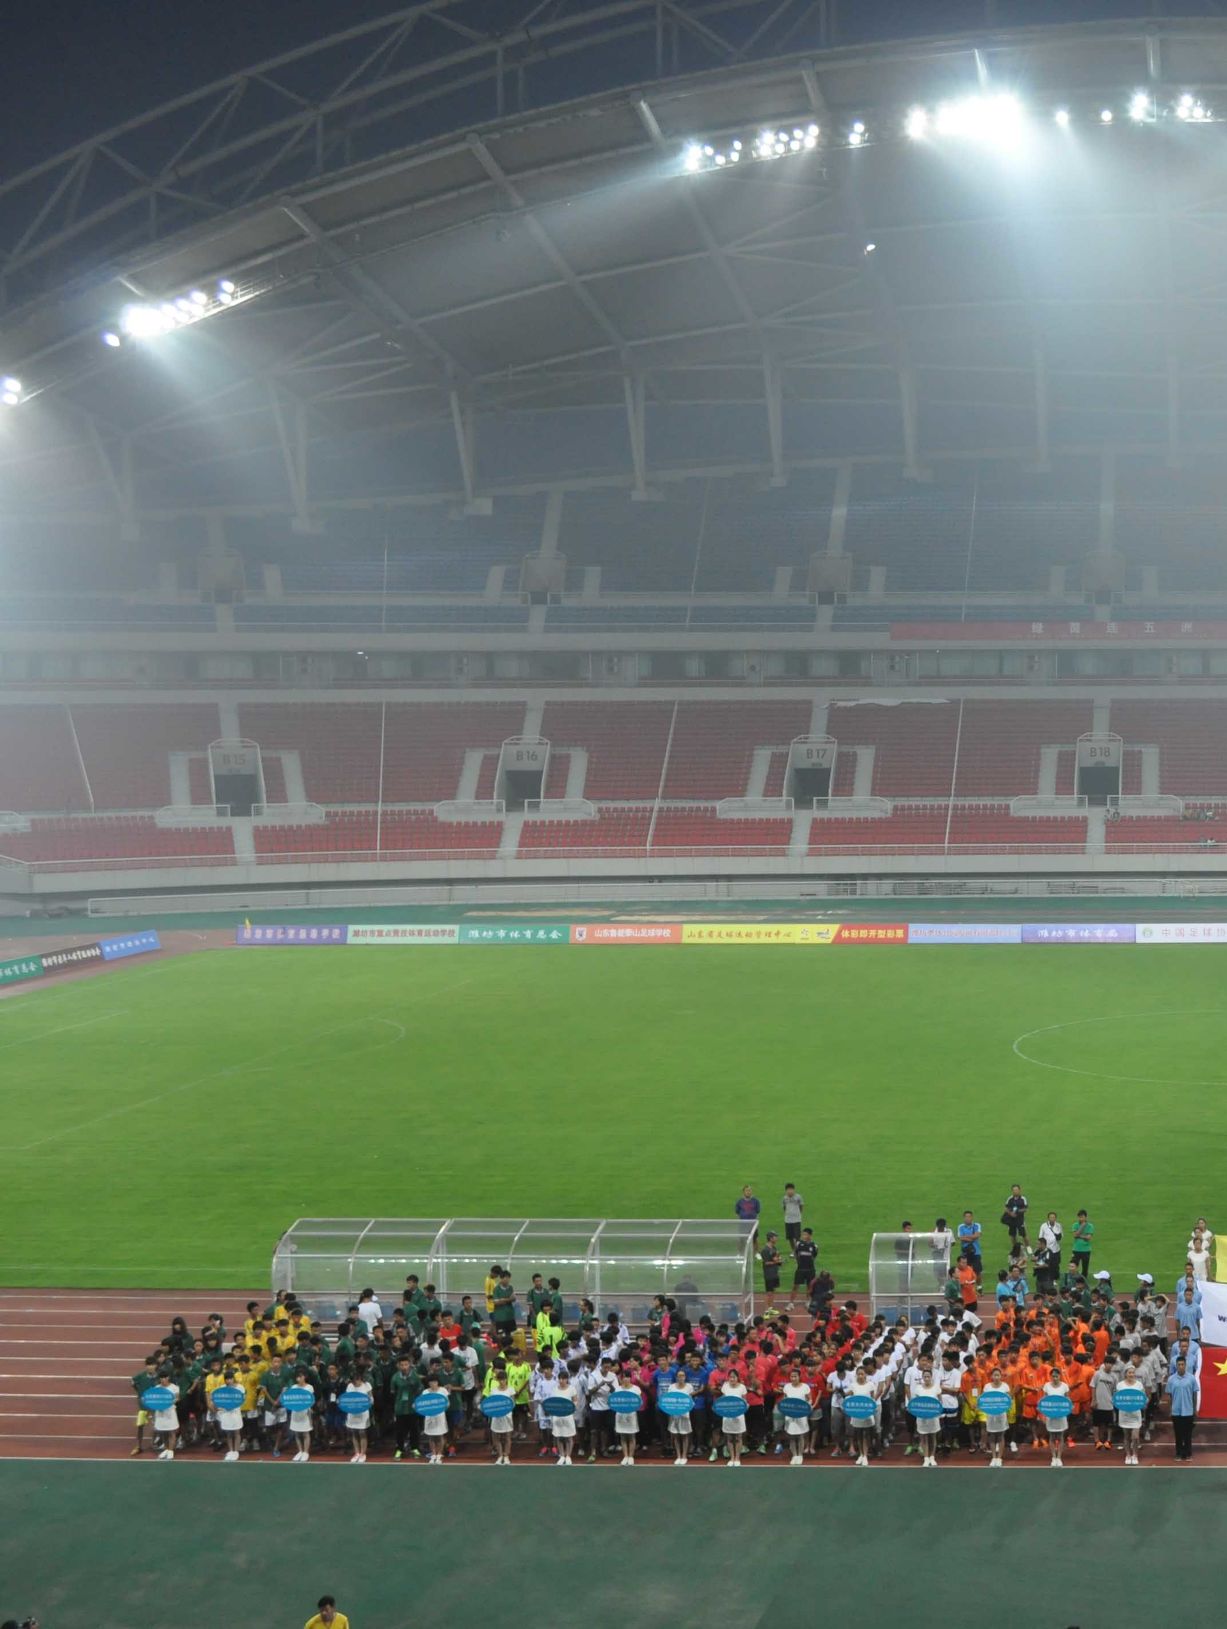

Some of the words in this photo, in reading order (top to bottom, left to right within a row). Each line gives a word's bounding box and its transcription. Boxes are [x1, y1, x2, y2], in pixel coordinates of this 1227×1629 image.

[468, 928, 563, 940] 潍坊市体育总会
[594, 928, 672, 937] 山东鲁能泰山足球学校
[841, 929, 905, 939] 体彩即开型彩票
